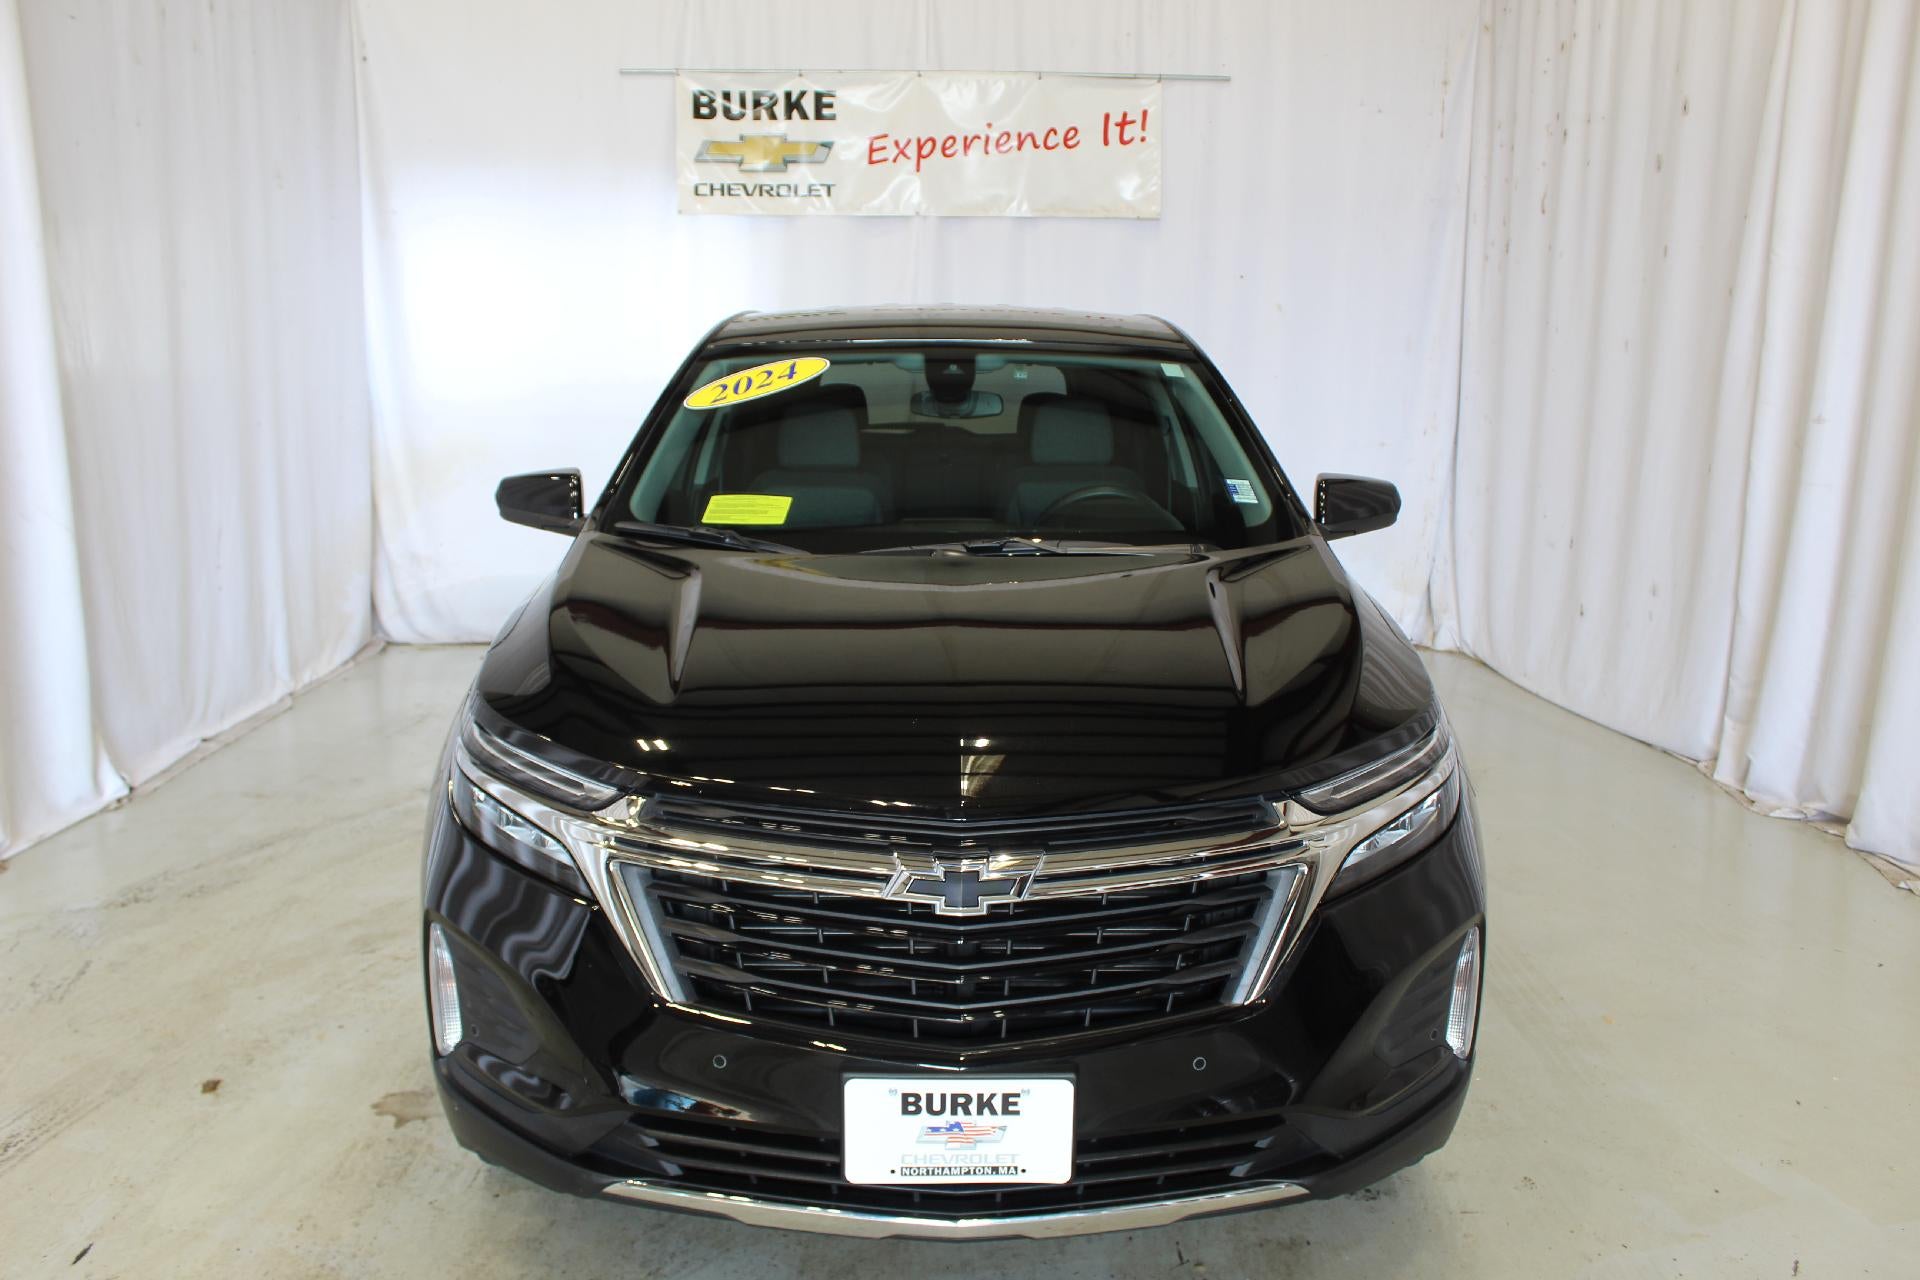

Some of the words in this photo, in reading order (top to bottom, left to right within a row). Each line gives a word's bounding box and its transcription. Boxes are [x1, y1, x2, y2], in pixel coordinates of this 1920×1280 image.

[692, 89, 837, 121] BURKE
[866, 122, 1081, 172] Experience
[1102, 109, 1149, 147] It!
[693, 182, 836, 197] CHEVROLET
[710, 361, 797, 404] 2024
[901, 1093, 1021, 1116] BURKE
[900, 1154, 1019, 1165] CHEVROLET
[999, 1167, 1017, 1175] MA
